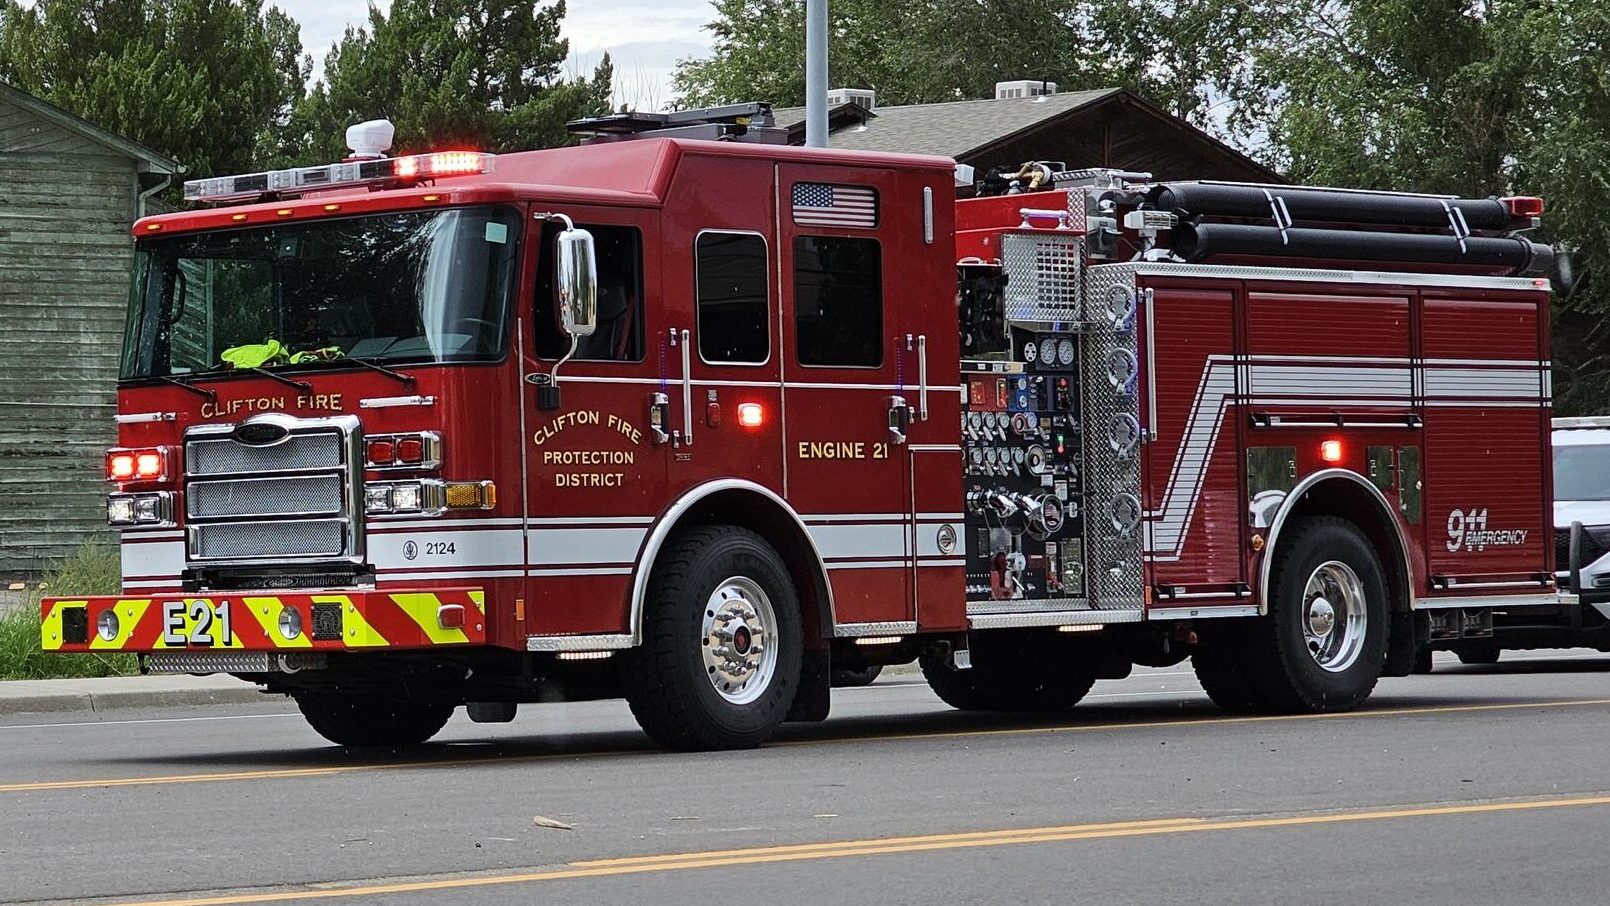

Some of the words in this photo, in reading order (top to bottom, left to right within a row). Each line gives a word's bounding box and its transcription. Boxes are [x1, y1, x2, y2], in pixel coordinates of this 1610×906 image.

[200, 396, 284, 418] CLIFTON
[297, 393, 343, 411] FIRE
[533, 410, 599, 445] CLIFTON
[607, 414, 642, 445] FIRE
[543, 451, 634, 464] PROTECTION
[798, 441, 865, 459] ENGINE
[872, 442, 888, 459] 21
[555, 473, 624, 487] DISTRICT
[1446, 508, 1488, 552] 911
[1464, 529, 1528, 546] EMERGENCY
[426, 542, 456, 555] 2124
[162, 599, 232, 646] E21
